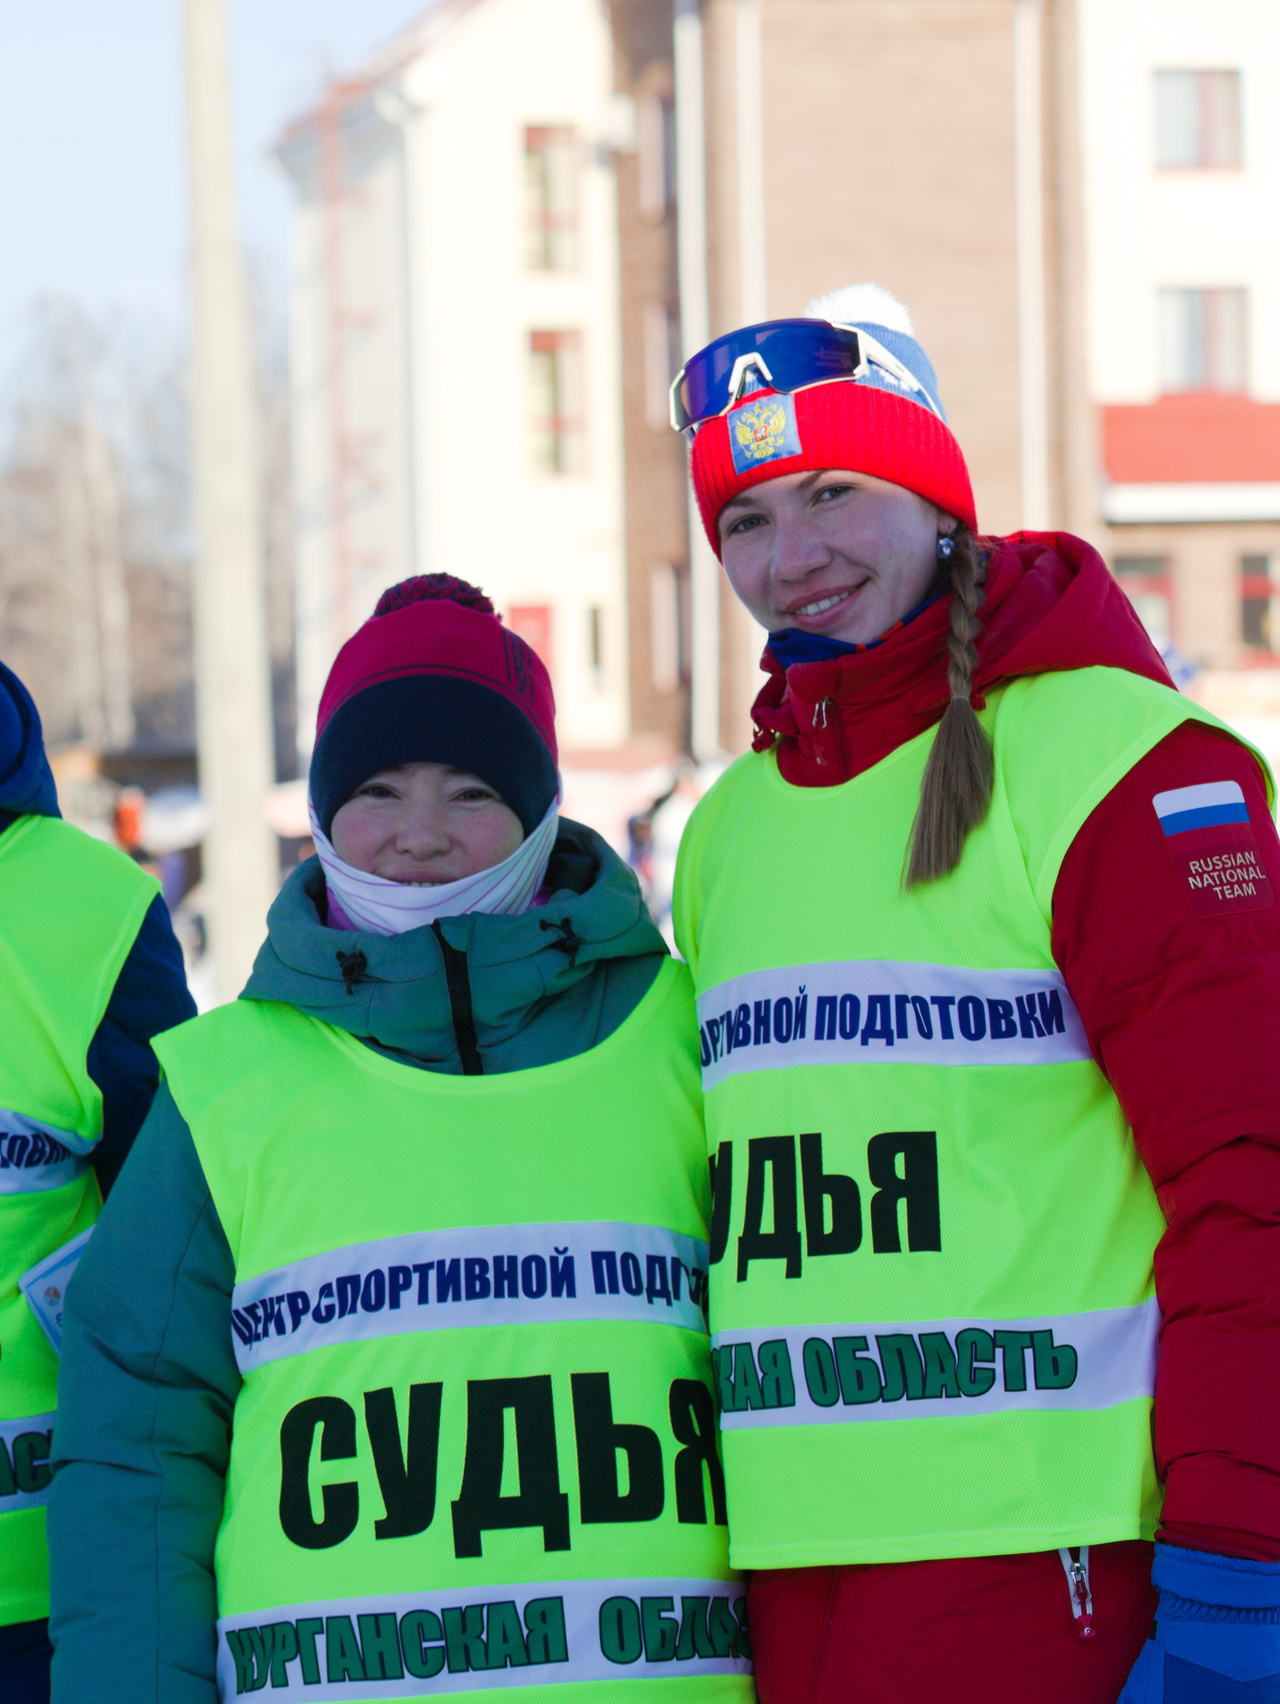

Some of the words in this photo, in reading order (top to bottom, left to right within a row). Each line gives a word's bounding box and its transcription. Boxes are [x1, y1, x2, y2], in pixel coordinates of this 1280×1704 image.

[1187, 866, 1266, 890] NATIONAL
[1189, 851, 1256, 875] RUSSIAN
[1213, 882, 1256, 900] TEAM
[814, 988, 1065, 1046] ПОДГОТОВКИ
[311, 1246, 575, 1324] СПОРТИВНОЙ
[802, 1328, 1078, 1407] ОБЛАСТЬ
[279, 1372, 728, 1558] СУДЬЯ
[225, 1596, 569, 1694] КУРГАНСКАЯ
